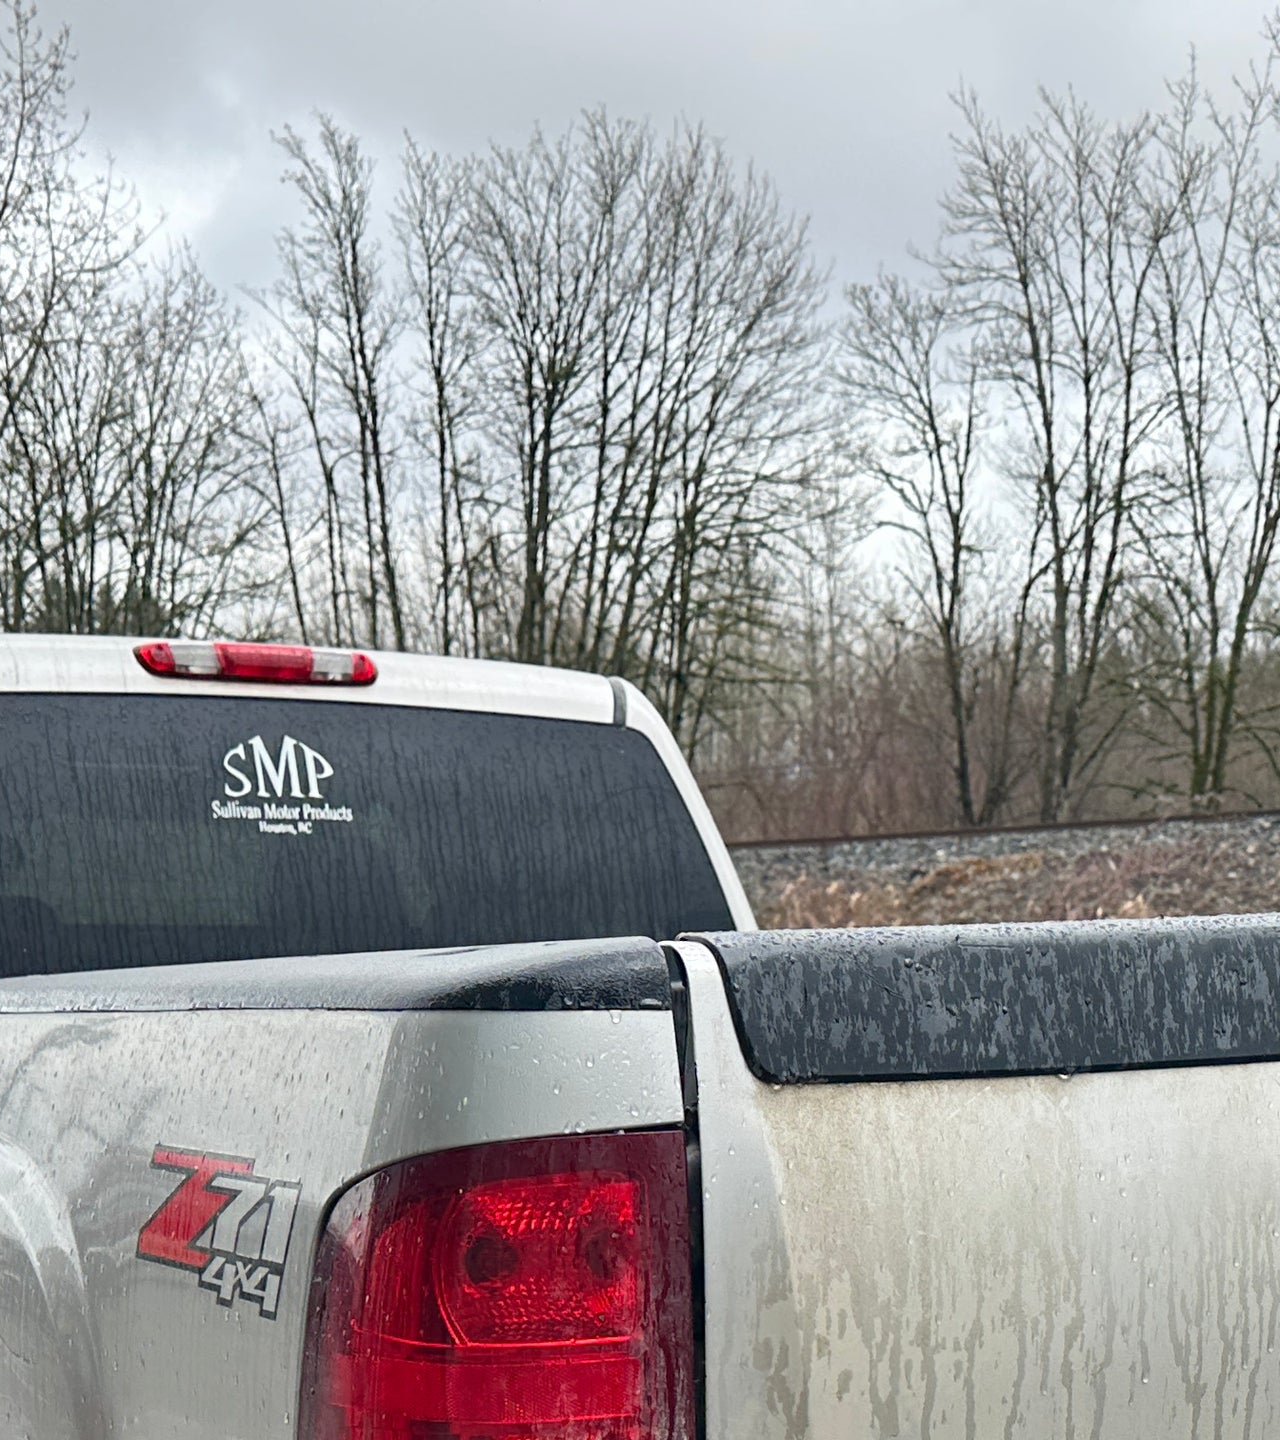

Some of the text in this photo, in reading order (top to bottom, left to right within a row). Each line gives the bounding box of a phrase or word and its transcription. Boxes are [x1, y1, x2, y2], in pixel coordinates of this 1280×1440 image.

[223, 735, 333, 798] SMP
[211, 800, 353, 822] Sullivan Motor Products
[136, 1143, 303, 1274] Z71
